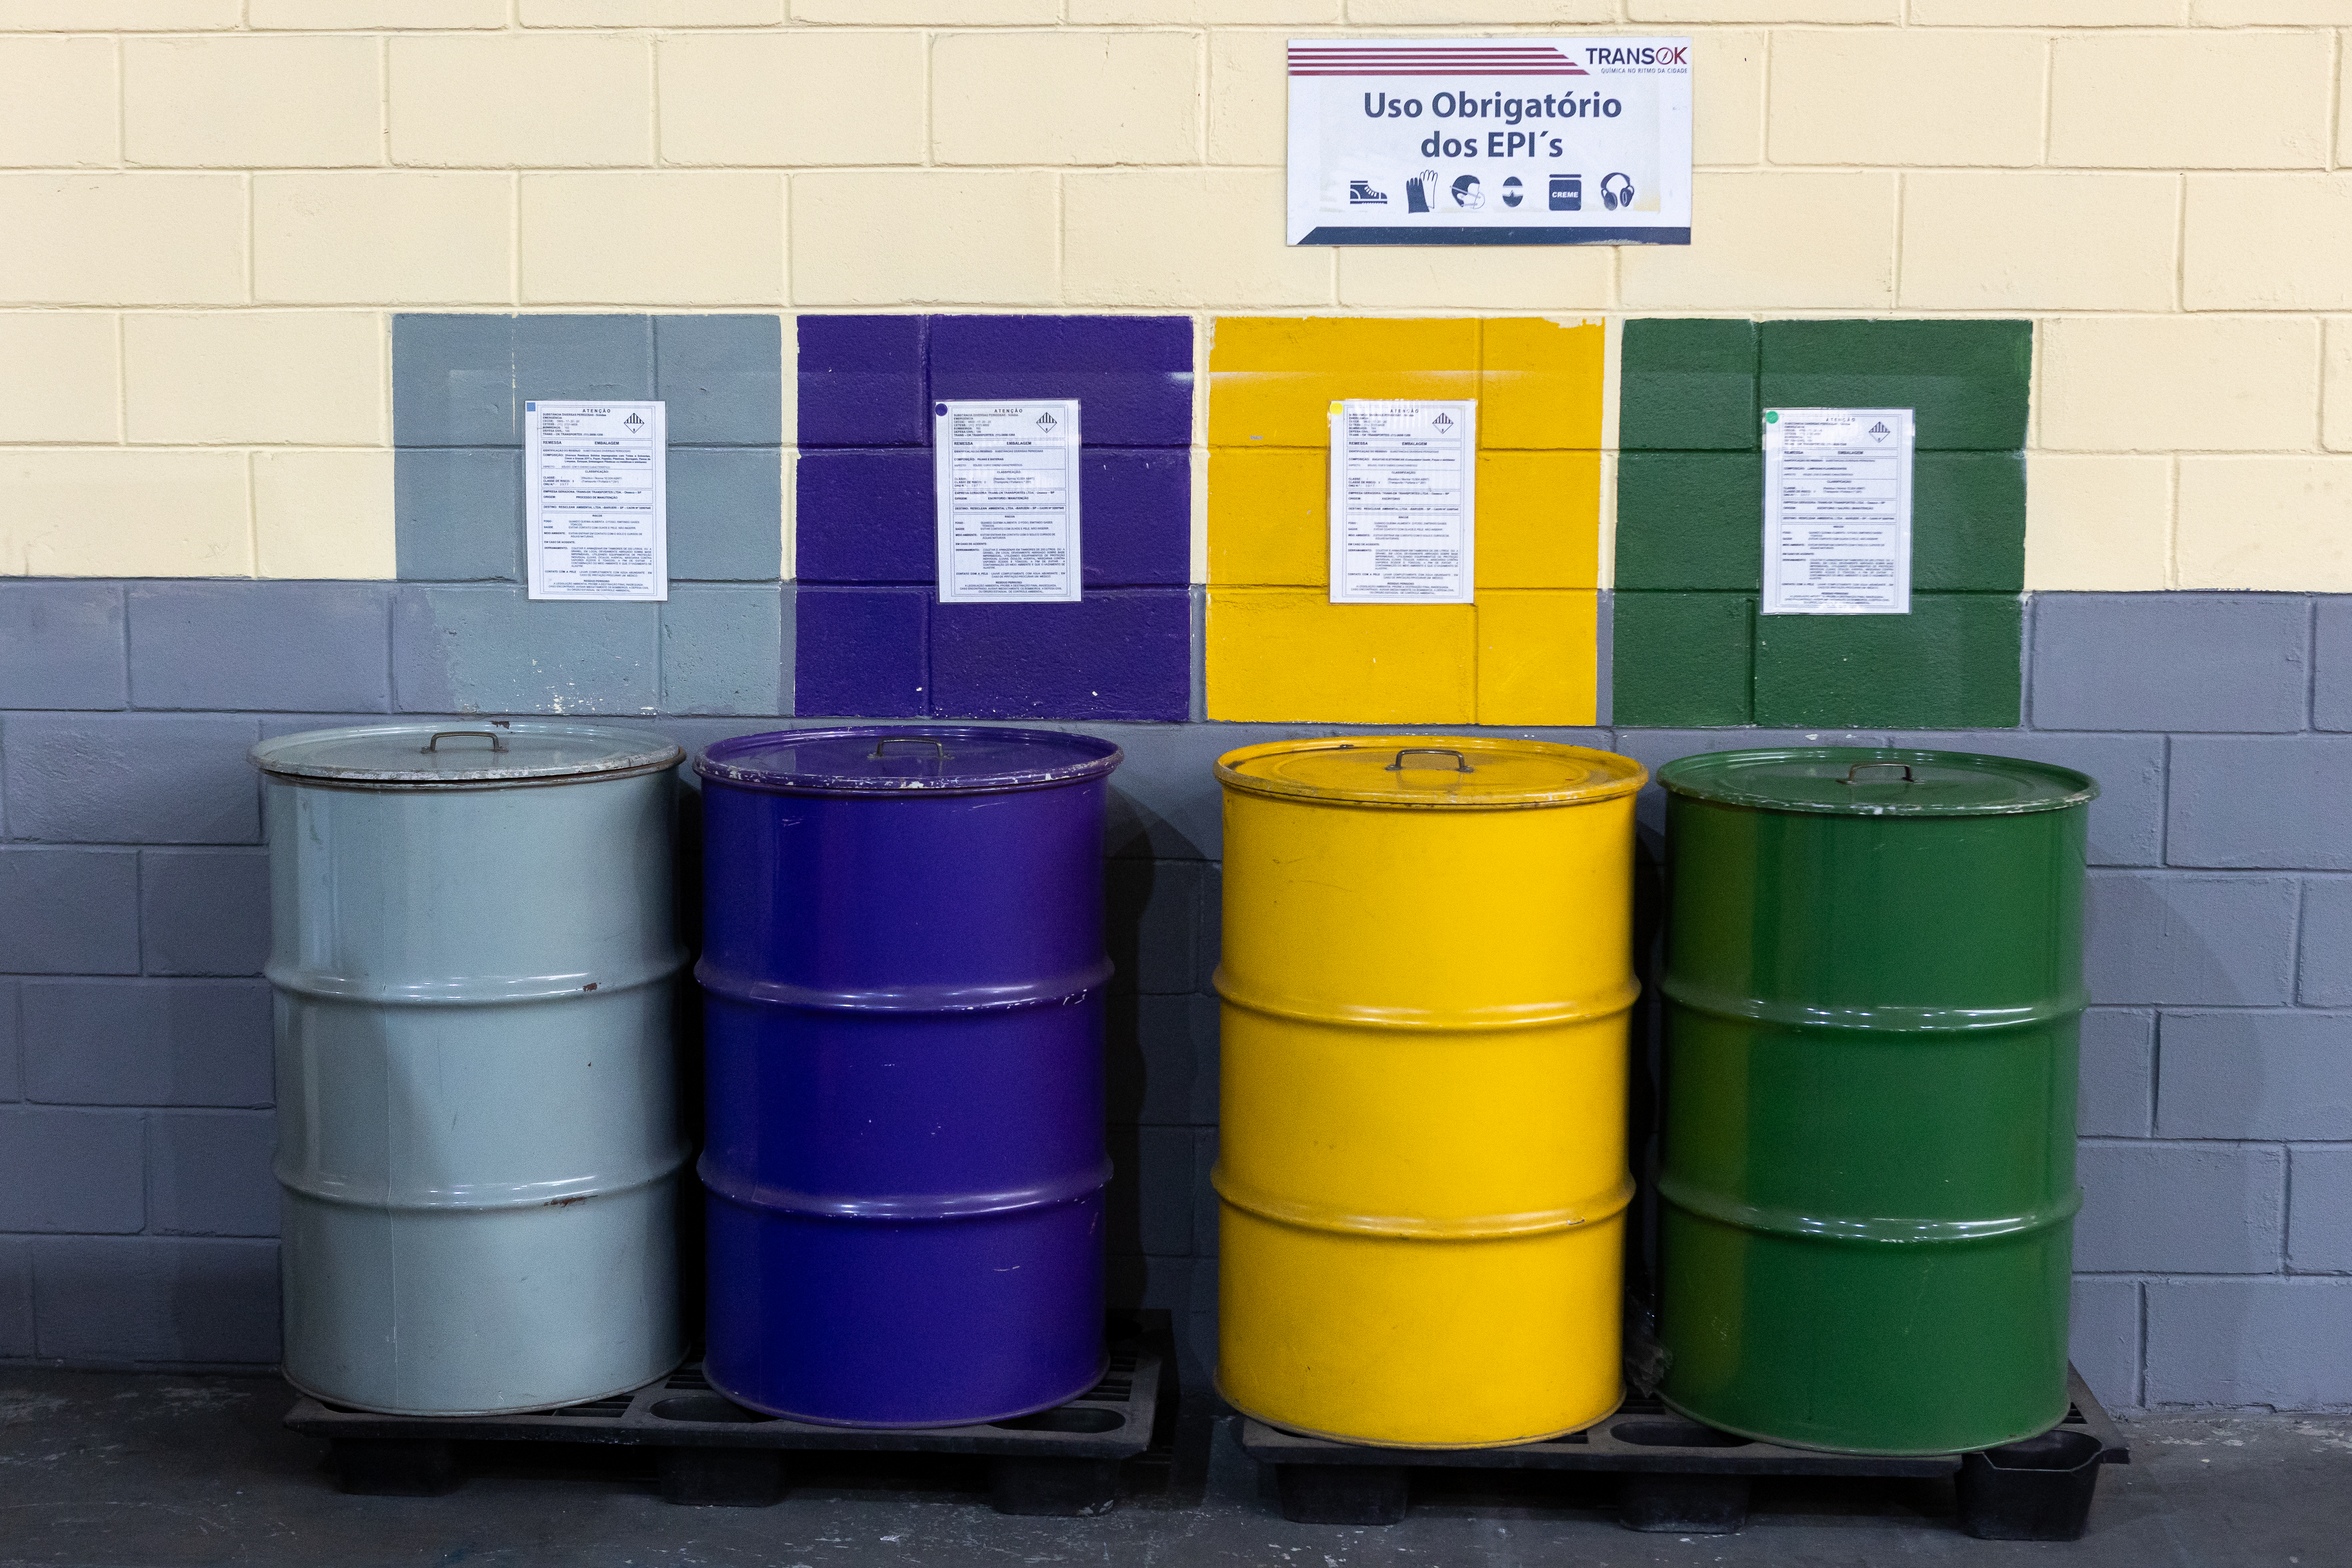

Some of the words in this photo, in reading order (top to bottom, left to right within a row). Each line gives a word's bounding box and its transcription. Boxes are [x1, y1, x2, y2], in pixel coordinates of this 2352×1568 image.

[1365, 92, 1423, 117] Uso
[1432, 91, 1622, 125] Obrigatório
[1421, 131, 1478, 158] dos
